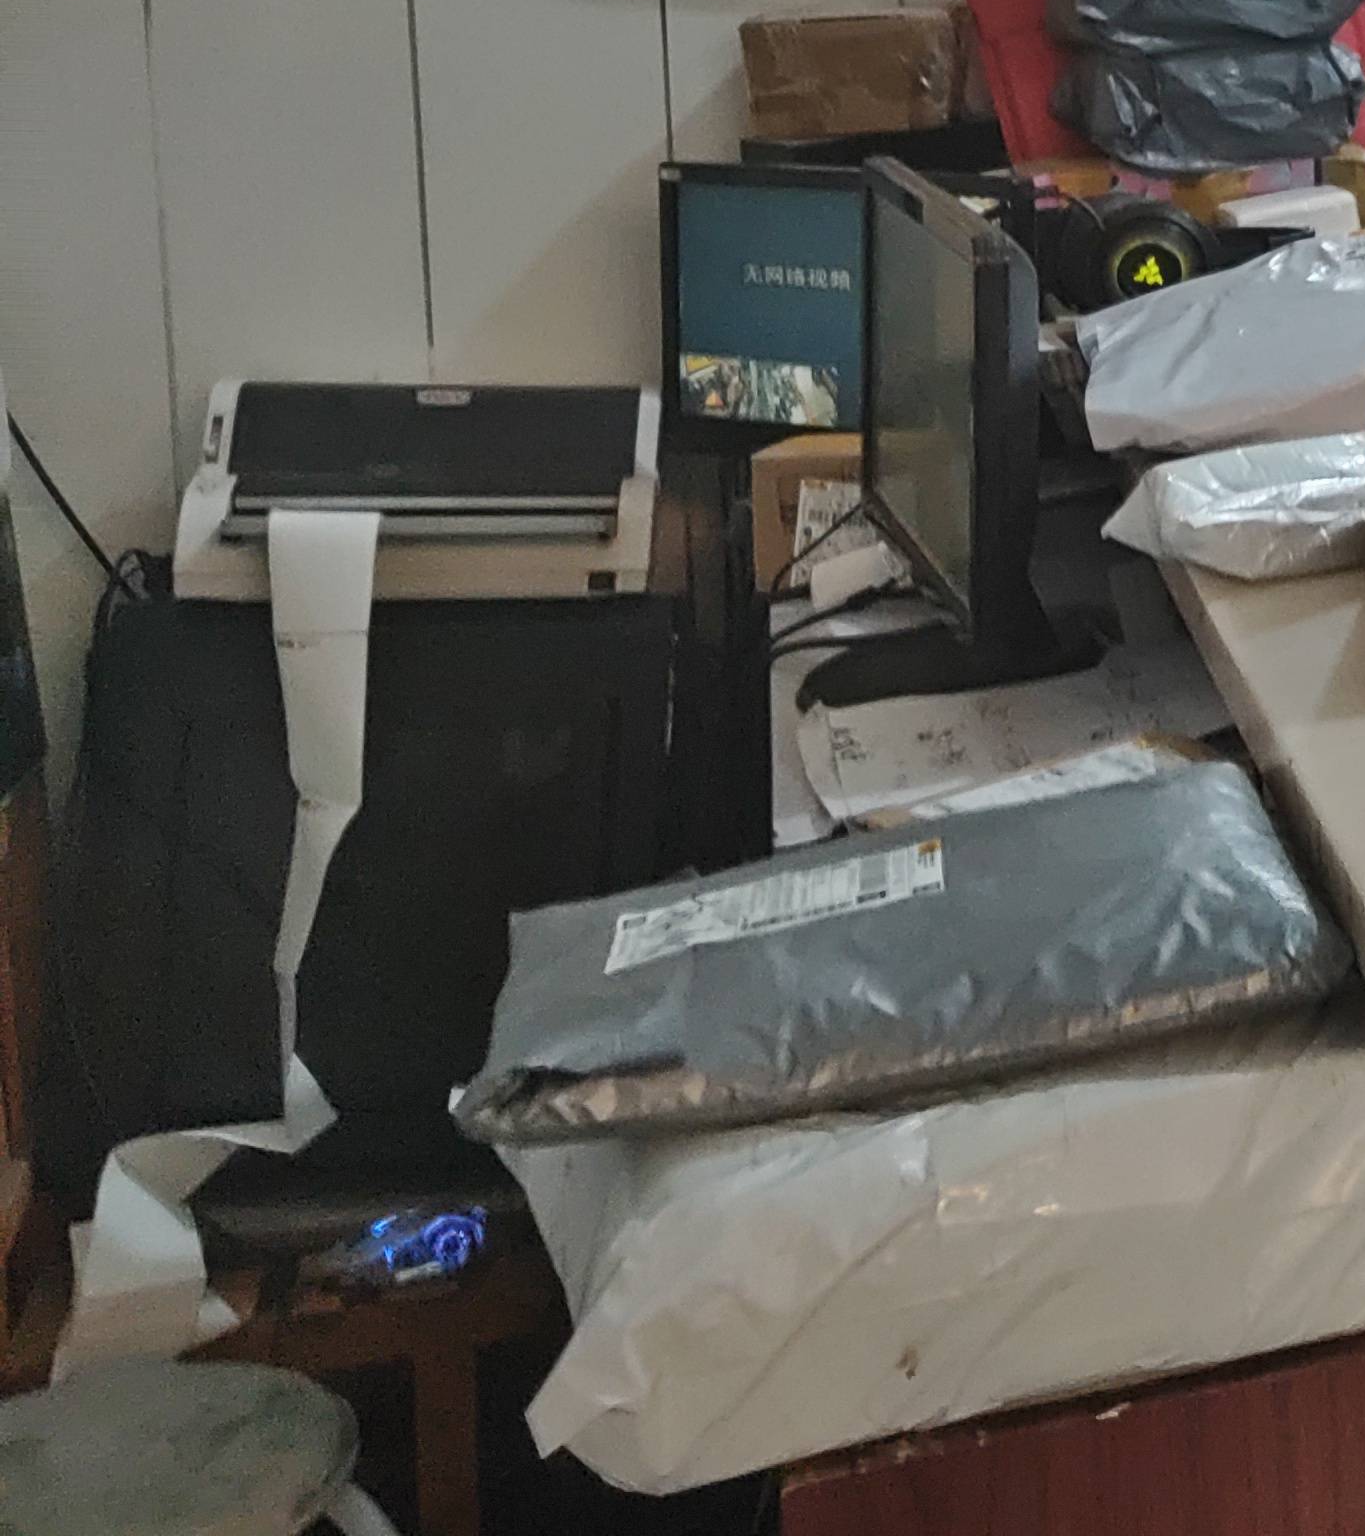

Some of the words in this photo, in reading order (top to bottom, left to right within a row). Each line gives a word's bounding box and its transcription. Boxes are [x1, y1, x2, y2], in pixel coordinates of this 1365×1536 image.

[743, 263, 851, 291] 无网络视频
